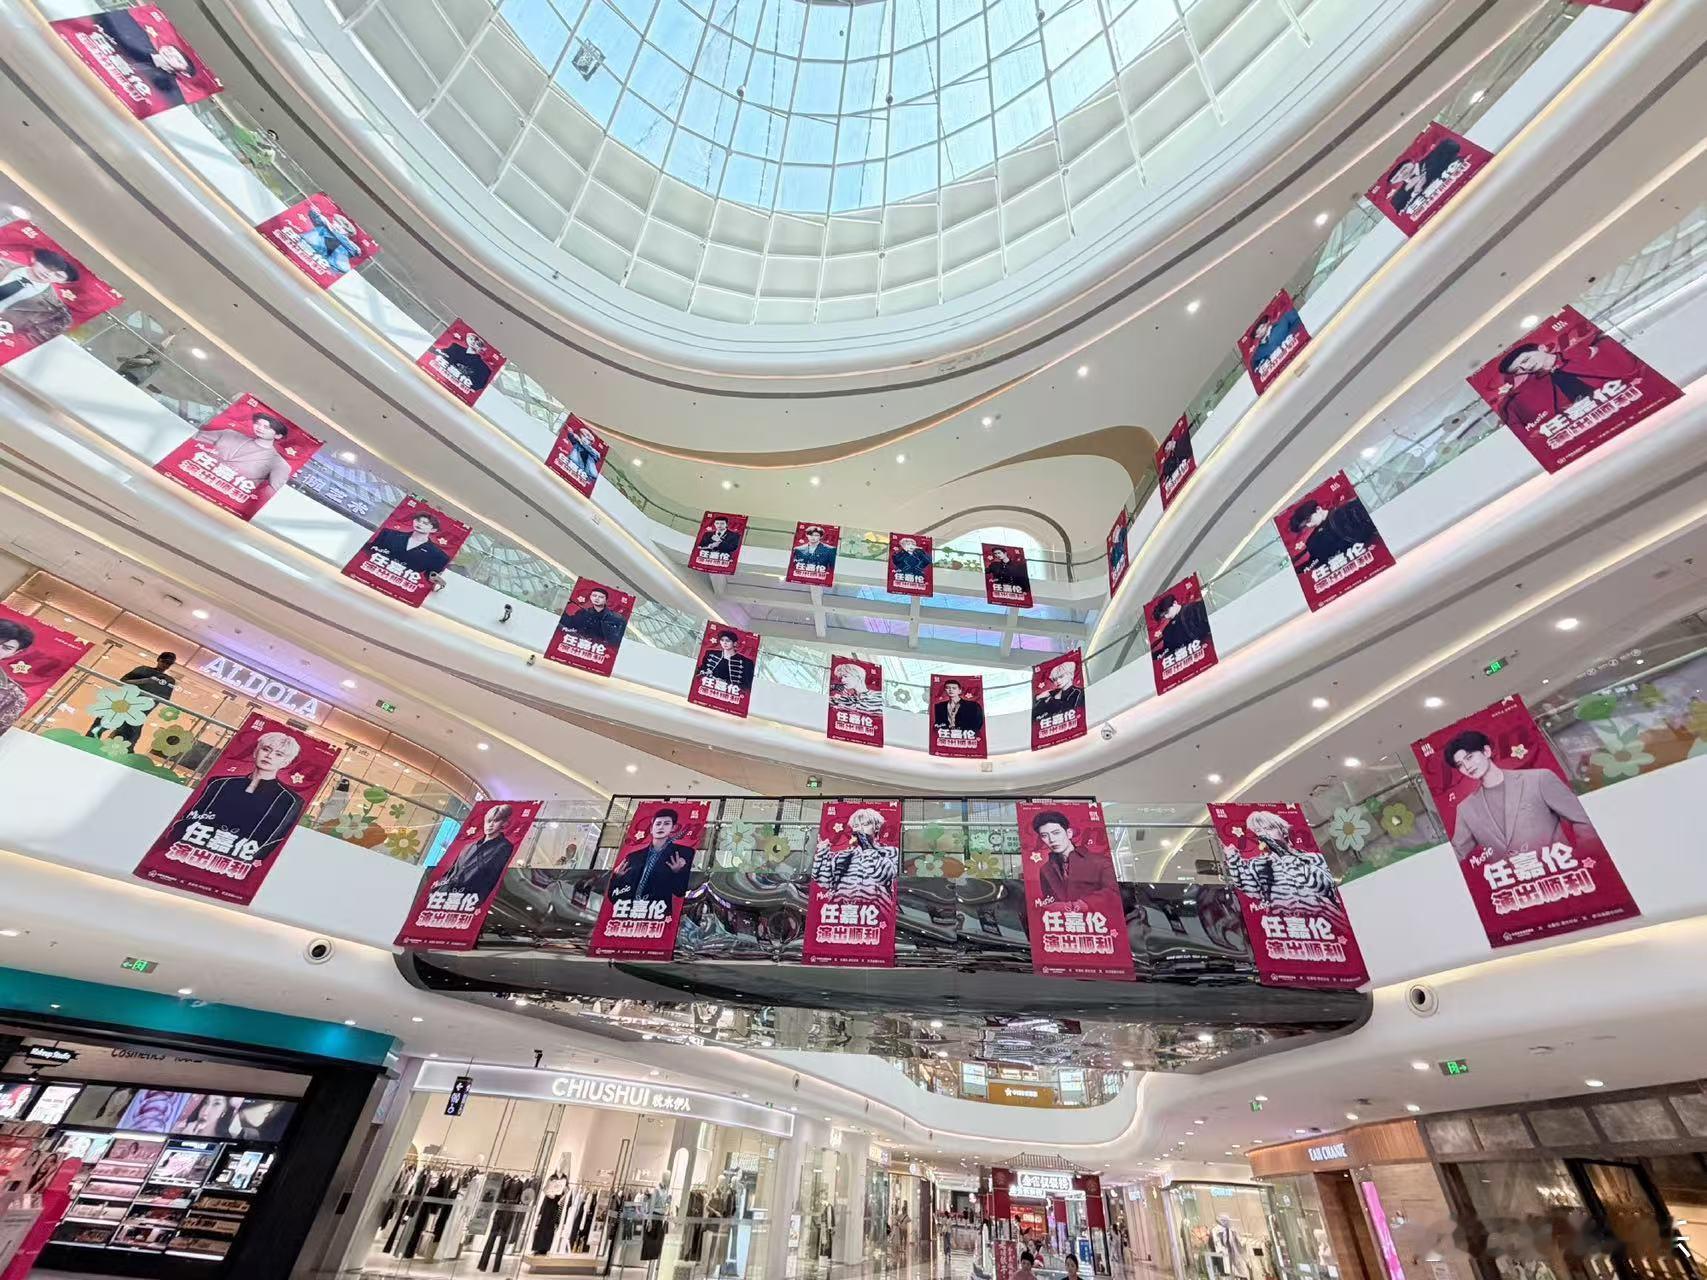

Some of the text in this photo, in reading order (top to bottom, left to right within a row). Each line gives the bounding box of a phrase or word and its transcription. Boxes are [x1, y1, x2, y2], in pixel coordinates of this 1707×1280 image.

[1539, 379, 1628, 437] 任嘉伦
[1524, 410, 1549, 432] Music
[192, 451, 256, 494] 任嘉伦
[370, 552, 421, 584] 任嘉伦
[1311, 542, 1367, 583] 任嘉伦
[563, 633, 606, 655] 任嘉伦
[1162, 639, 1202, 669] 任嘉伦
[198, 655, 318, 719] ALDOLA
[836, 711, 873, 727] 任嘉伦
[937, 728, 976, 740] 任嘉伦
[186, 810, 216, 820] Music
[182, 821, 259, 861] 任嘉伦
[165, 841, 252, 881] 演出顺利
[1483, 842, 1578, 890] 任嘉伦
[426, 891, 480, 912] 任嘉伦
[1034, 895, 1055, 908] Music
[1491, 868, 1596, 916] 演出顺利
[415, 910, 474, 930] 演出顺利
[611, 899, 667, 920] 任嘉伦
[820, 903, 880, 925] 任嘉伦
[604, 919, 665, 939] 演出顺利
[1042, 911, 1108, 934] 任嘉伦
[1261, 915, 1336, 940] 任嘉伦
[816, 925, 881, 946] 演出顺利
[1043, 933, 1114, 955] 演出顺利
[1265, 939, 1347, 963] 演出顺利
[551, 1077, 651, 1107] CHIUSHUI
